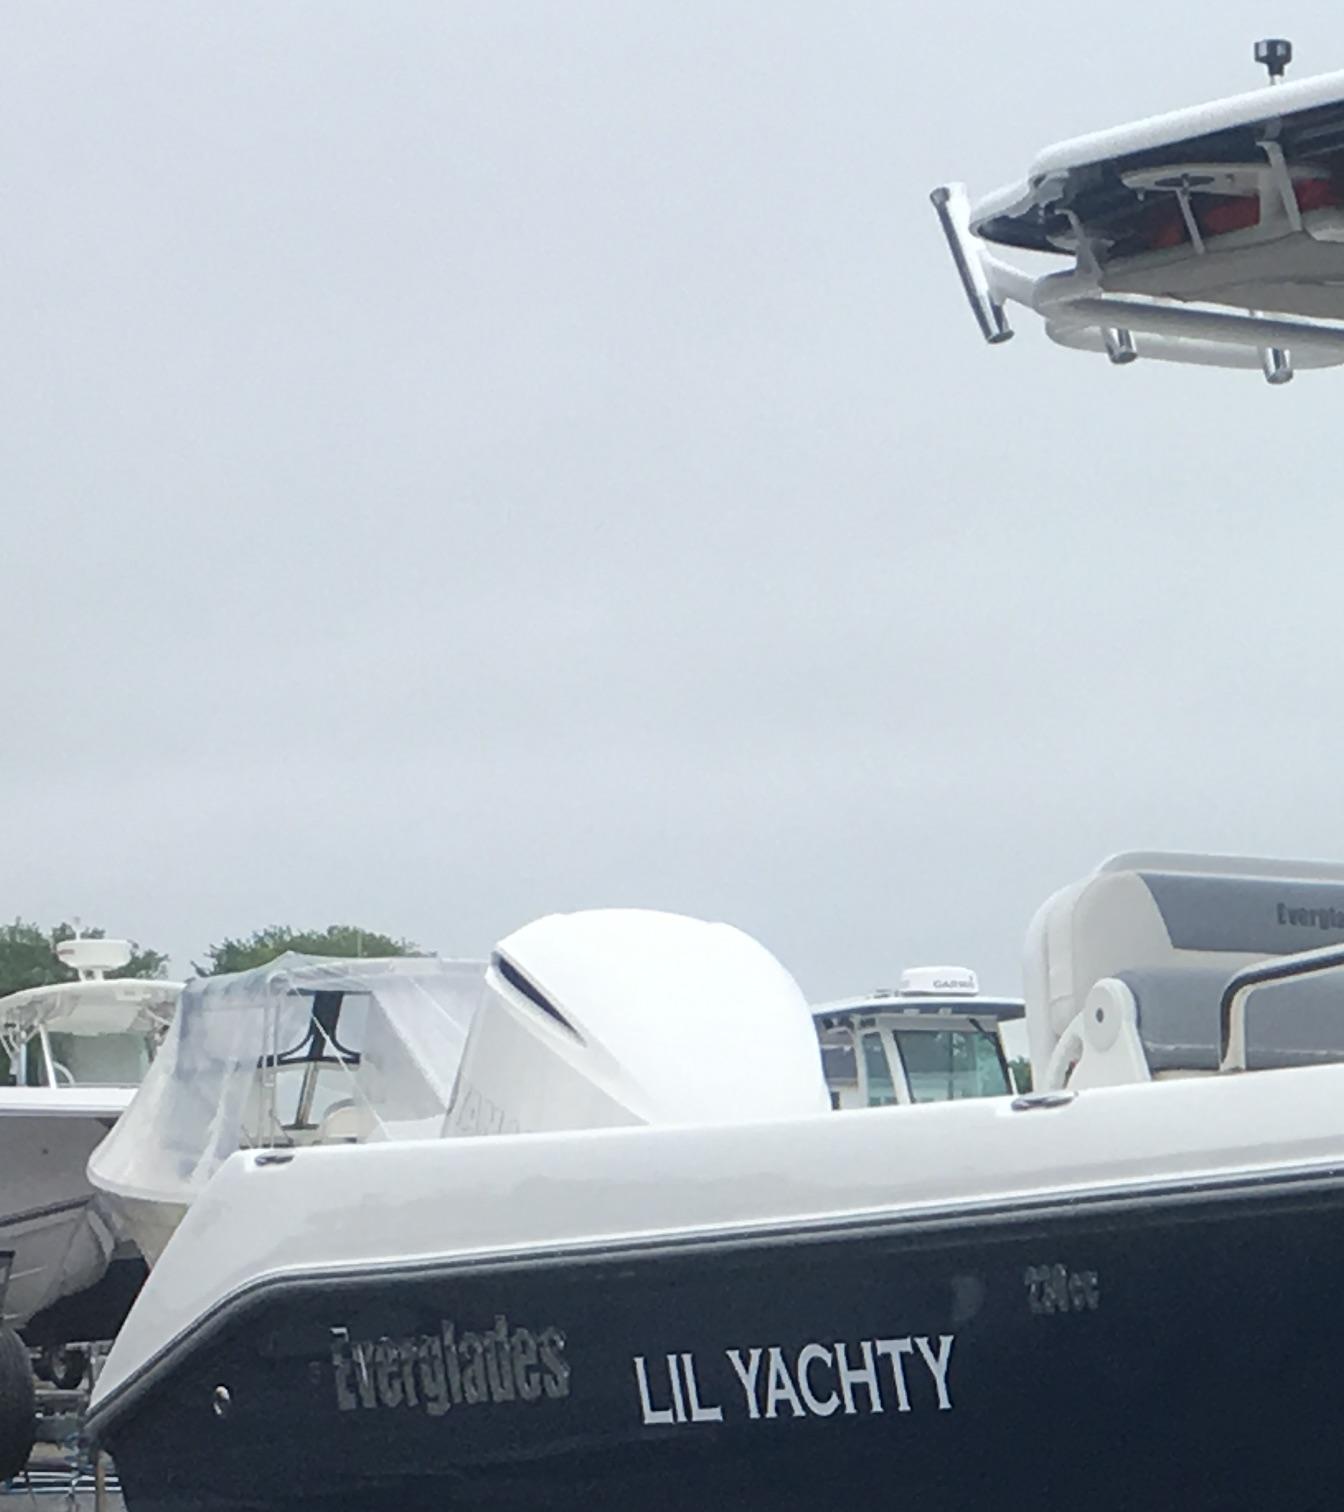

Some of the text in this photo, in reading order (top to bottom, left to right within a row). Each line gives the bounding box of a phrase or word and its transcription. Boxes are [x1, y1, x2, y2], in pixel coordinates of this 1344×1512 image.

[330, 1313, 572, 1416] Everglades
[632, 1334, 955, 1425] LIL YACHTY
